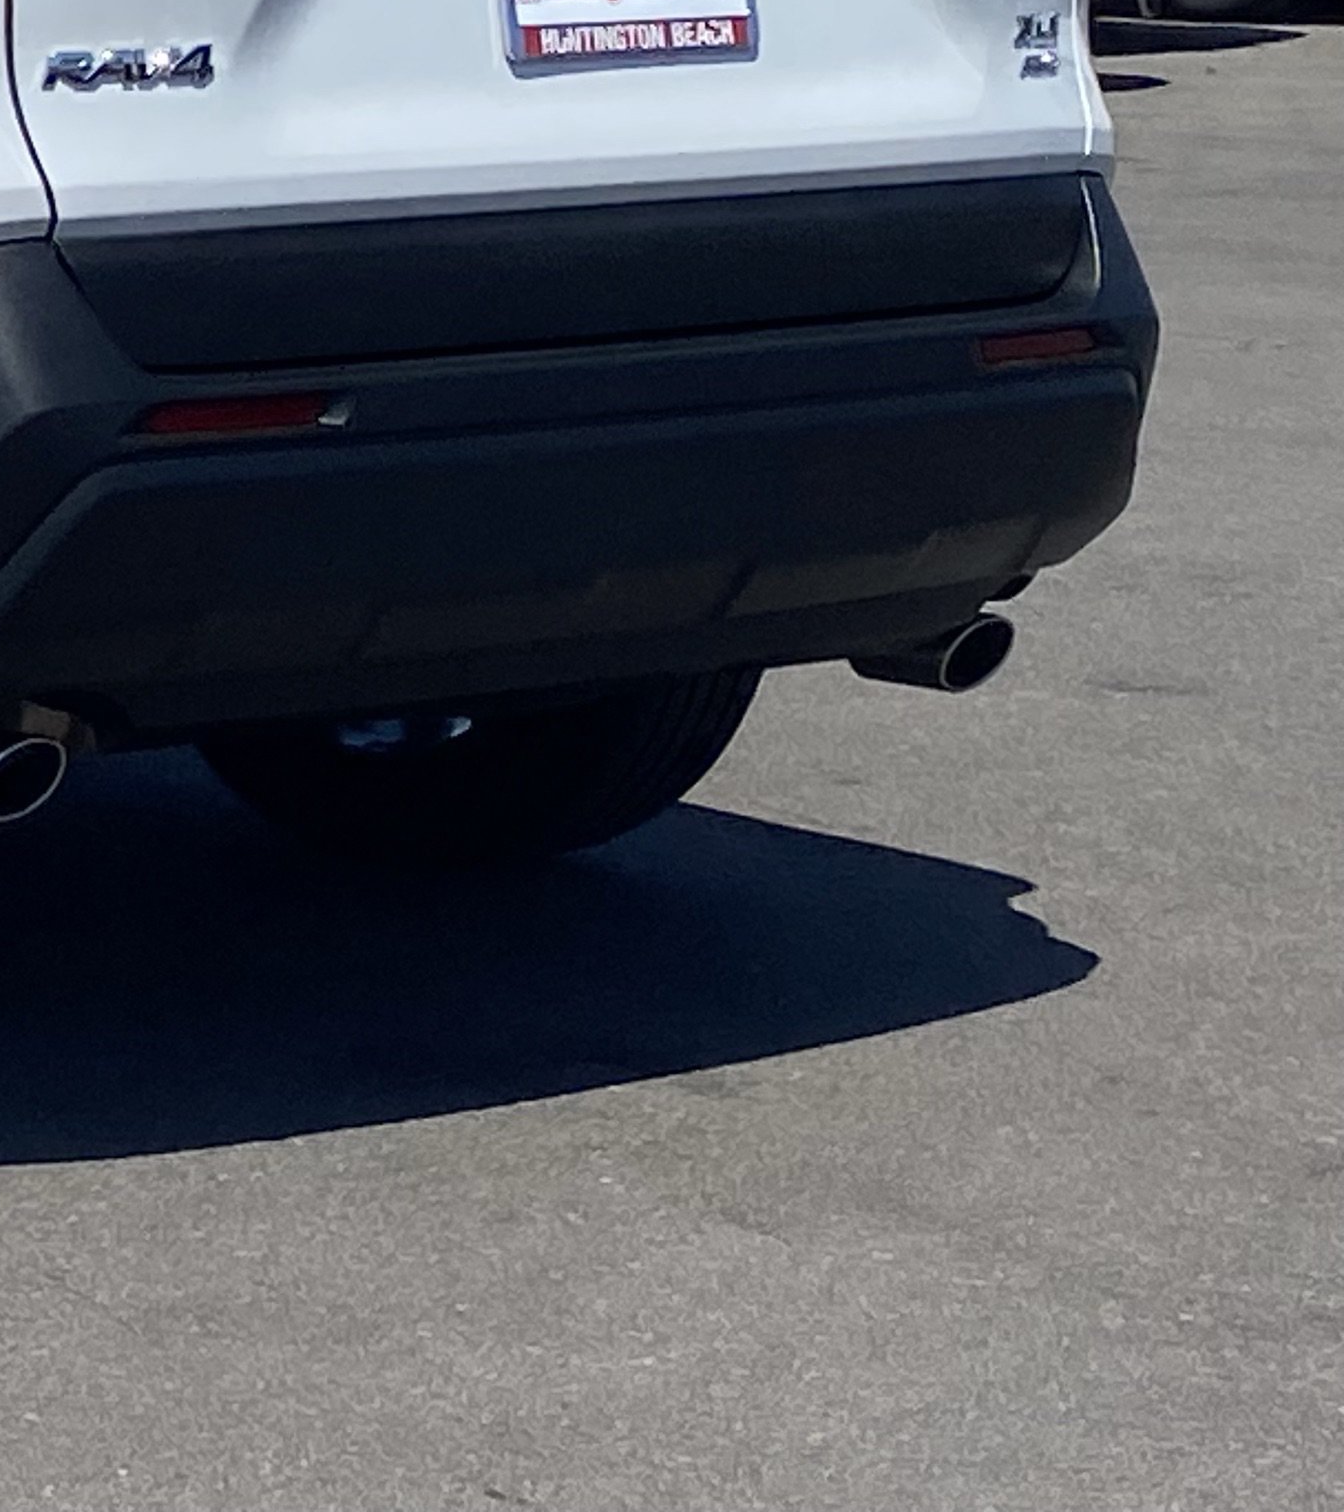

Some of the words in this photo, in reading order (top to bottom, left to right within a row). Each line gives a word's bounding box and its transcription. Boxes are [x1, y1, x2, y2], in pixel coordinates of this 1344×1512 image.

[540, 26, 666, 55] HUNTINGTON
[671, 19, 736, 47] BEACH
[42, 44, 215, 92] RAV4
